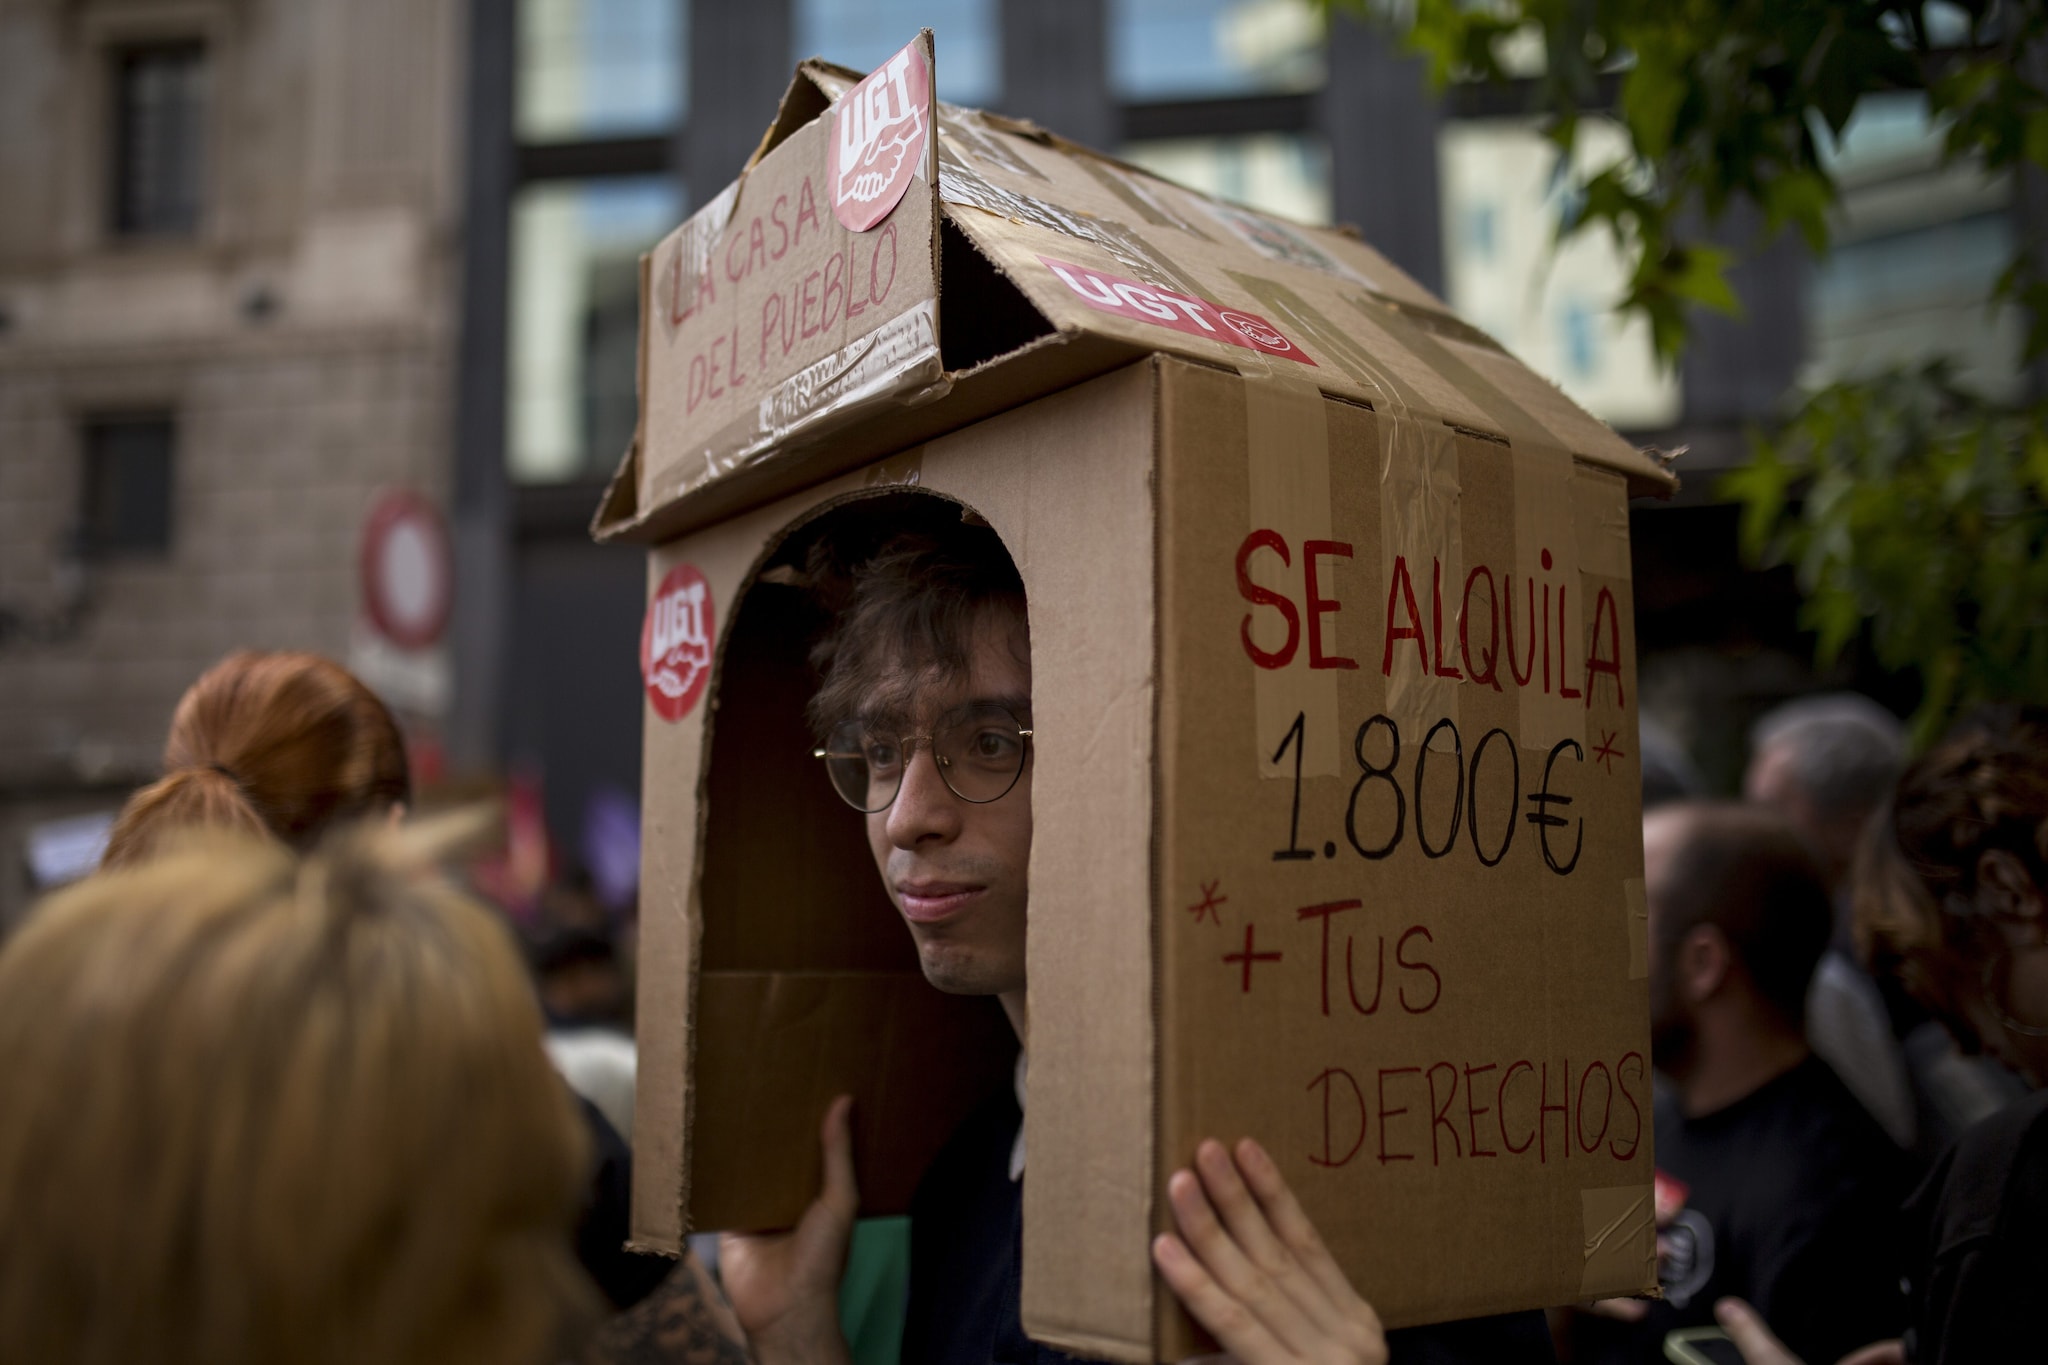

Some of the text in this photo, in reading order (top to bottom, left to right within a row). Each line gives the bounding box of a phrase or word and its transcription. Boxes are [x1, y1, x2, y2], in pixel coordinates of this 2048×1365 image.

[837, 45, 911, 173] UGT
[726, 174, 820, 283] CASA
[686, 224, 898, 416] DEL PUEBLO
[1051, 264, 1216, 333] UGT
[651, 580, 708, 663] UGT
[1235, 528, 1360, 670] SE
[1306, 1051, 1644, 1168] DERECHOS
